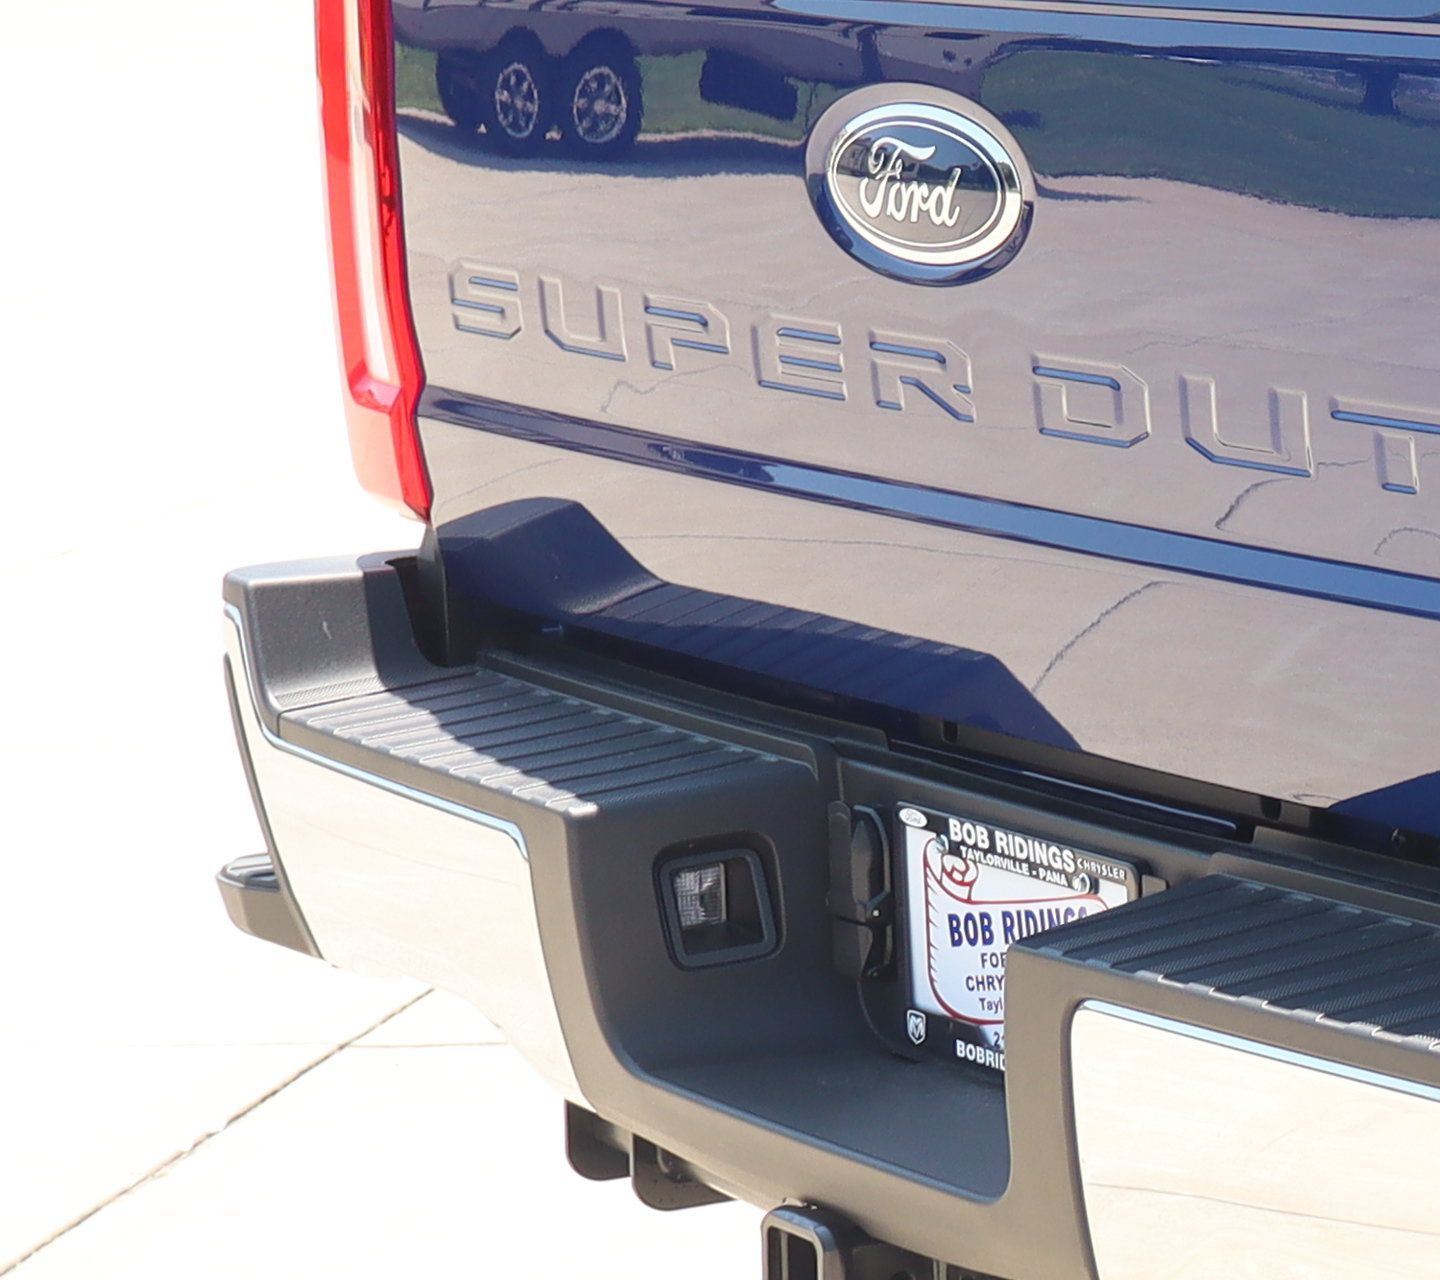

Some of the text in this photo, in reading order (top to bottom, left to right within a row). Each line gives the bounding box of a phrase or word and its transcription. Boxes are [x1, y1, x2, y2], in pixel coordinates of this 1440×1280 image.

[857, 135, 961, 232] Ford
[450, 259, 977, 424] SUPER
[948, 817, 1076, 874] BOB RIDINGS
[959, 845, 1029, 877] TAYLORVILLE
[1038, 866, 1068, 887] PANA
[1077, 857, 1126, 881] CHRYSLER
[947, 911, 995, 948] BOB
